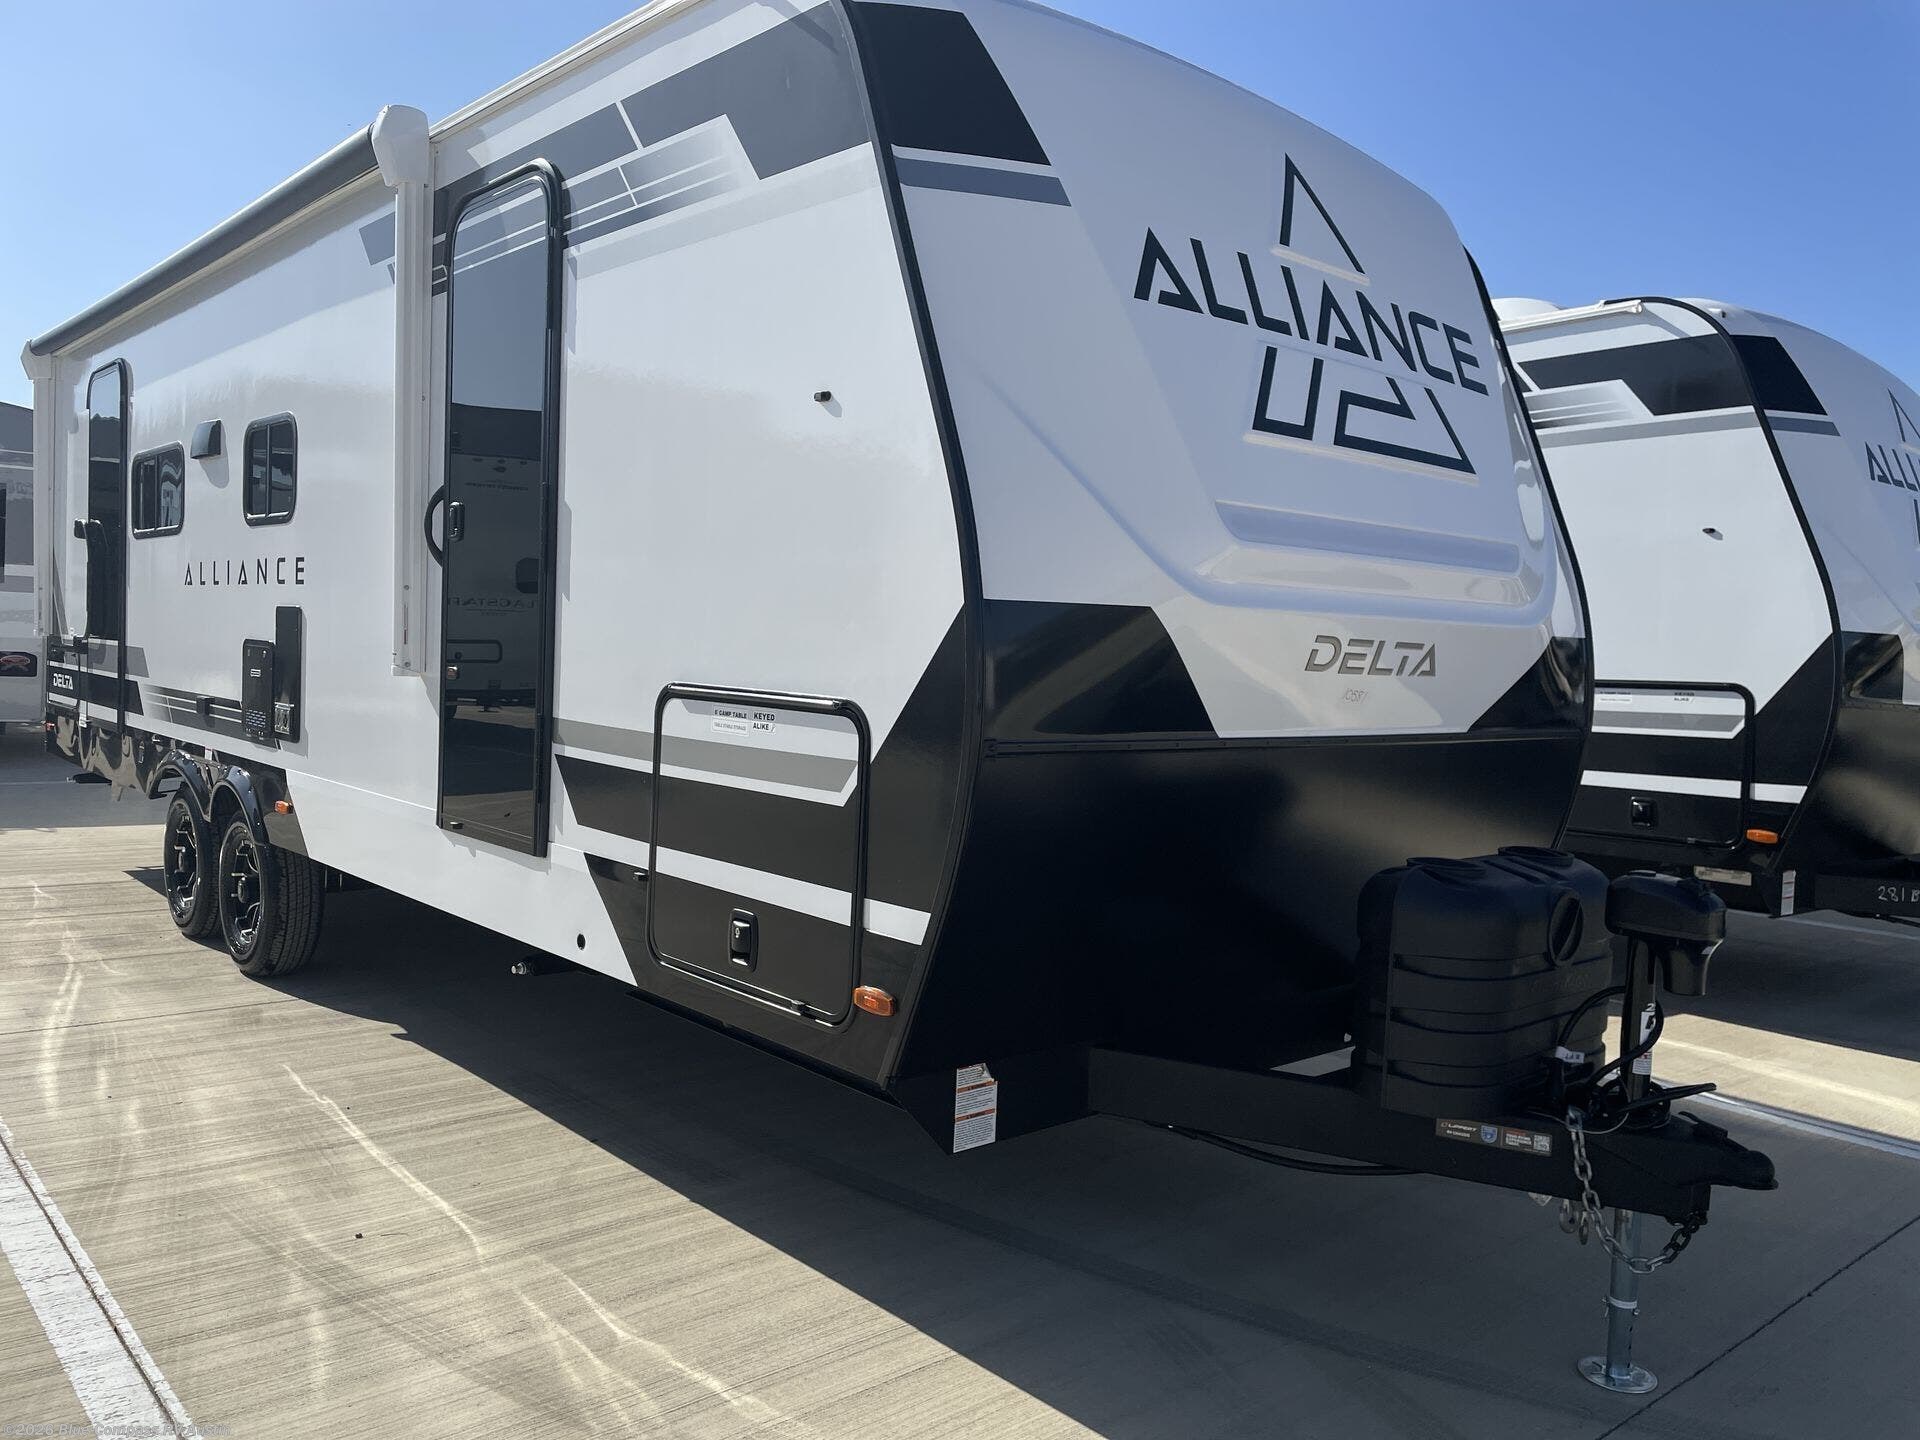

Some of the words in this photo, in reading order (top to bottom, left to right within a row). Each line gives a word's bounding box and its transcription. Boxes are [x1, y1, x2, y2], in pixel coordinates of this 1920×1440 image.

[1134, 226, 1489, 396] ALLIANCE
[1865, 441, 1920, 492] ALLI
[184, 557, 305, 586] ALLIANCE
[1304, 634, 1436, 677] DELTA
[53, 673, 74, 690] DELTA
[752, 722, 769, 731] ALIKE
[753, 711, 775, 721] KEYED
